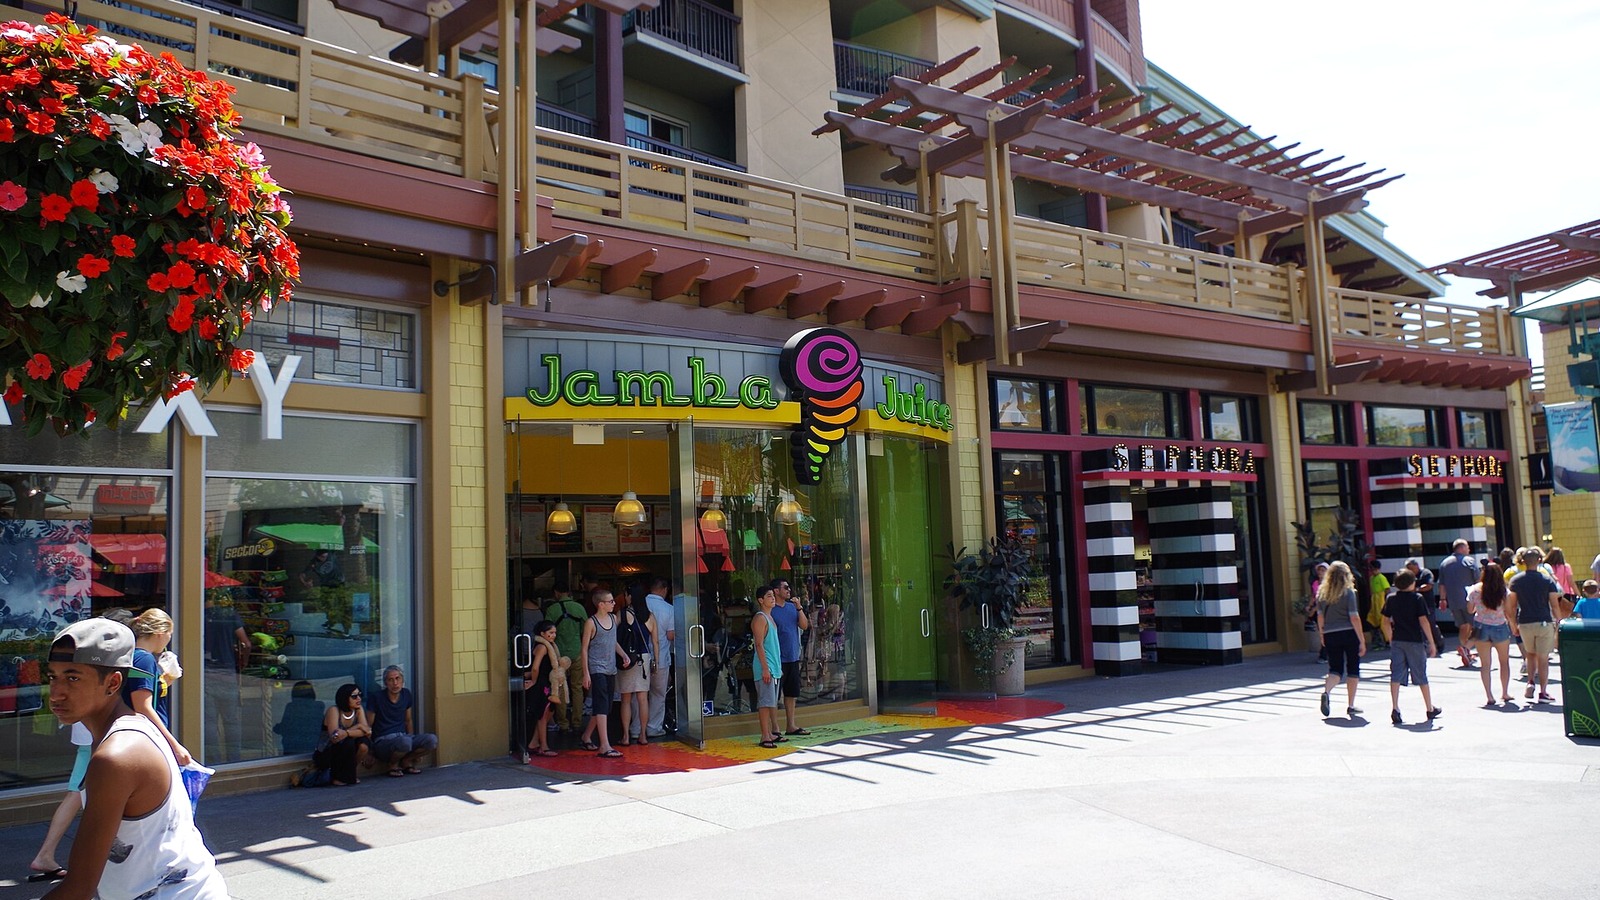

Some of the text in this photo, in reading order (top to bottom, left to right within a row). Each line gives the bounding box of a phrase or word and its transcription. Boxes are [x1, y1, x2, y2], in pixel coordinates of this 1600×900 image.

[527, 353, 954, 432] Jamba Juice
[1113, 443, 1255, 472] SEPHORA
[224, 544, 261, 560] sector
